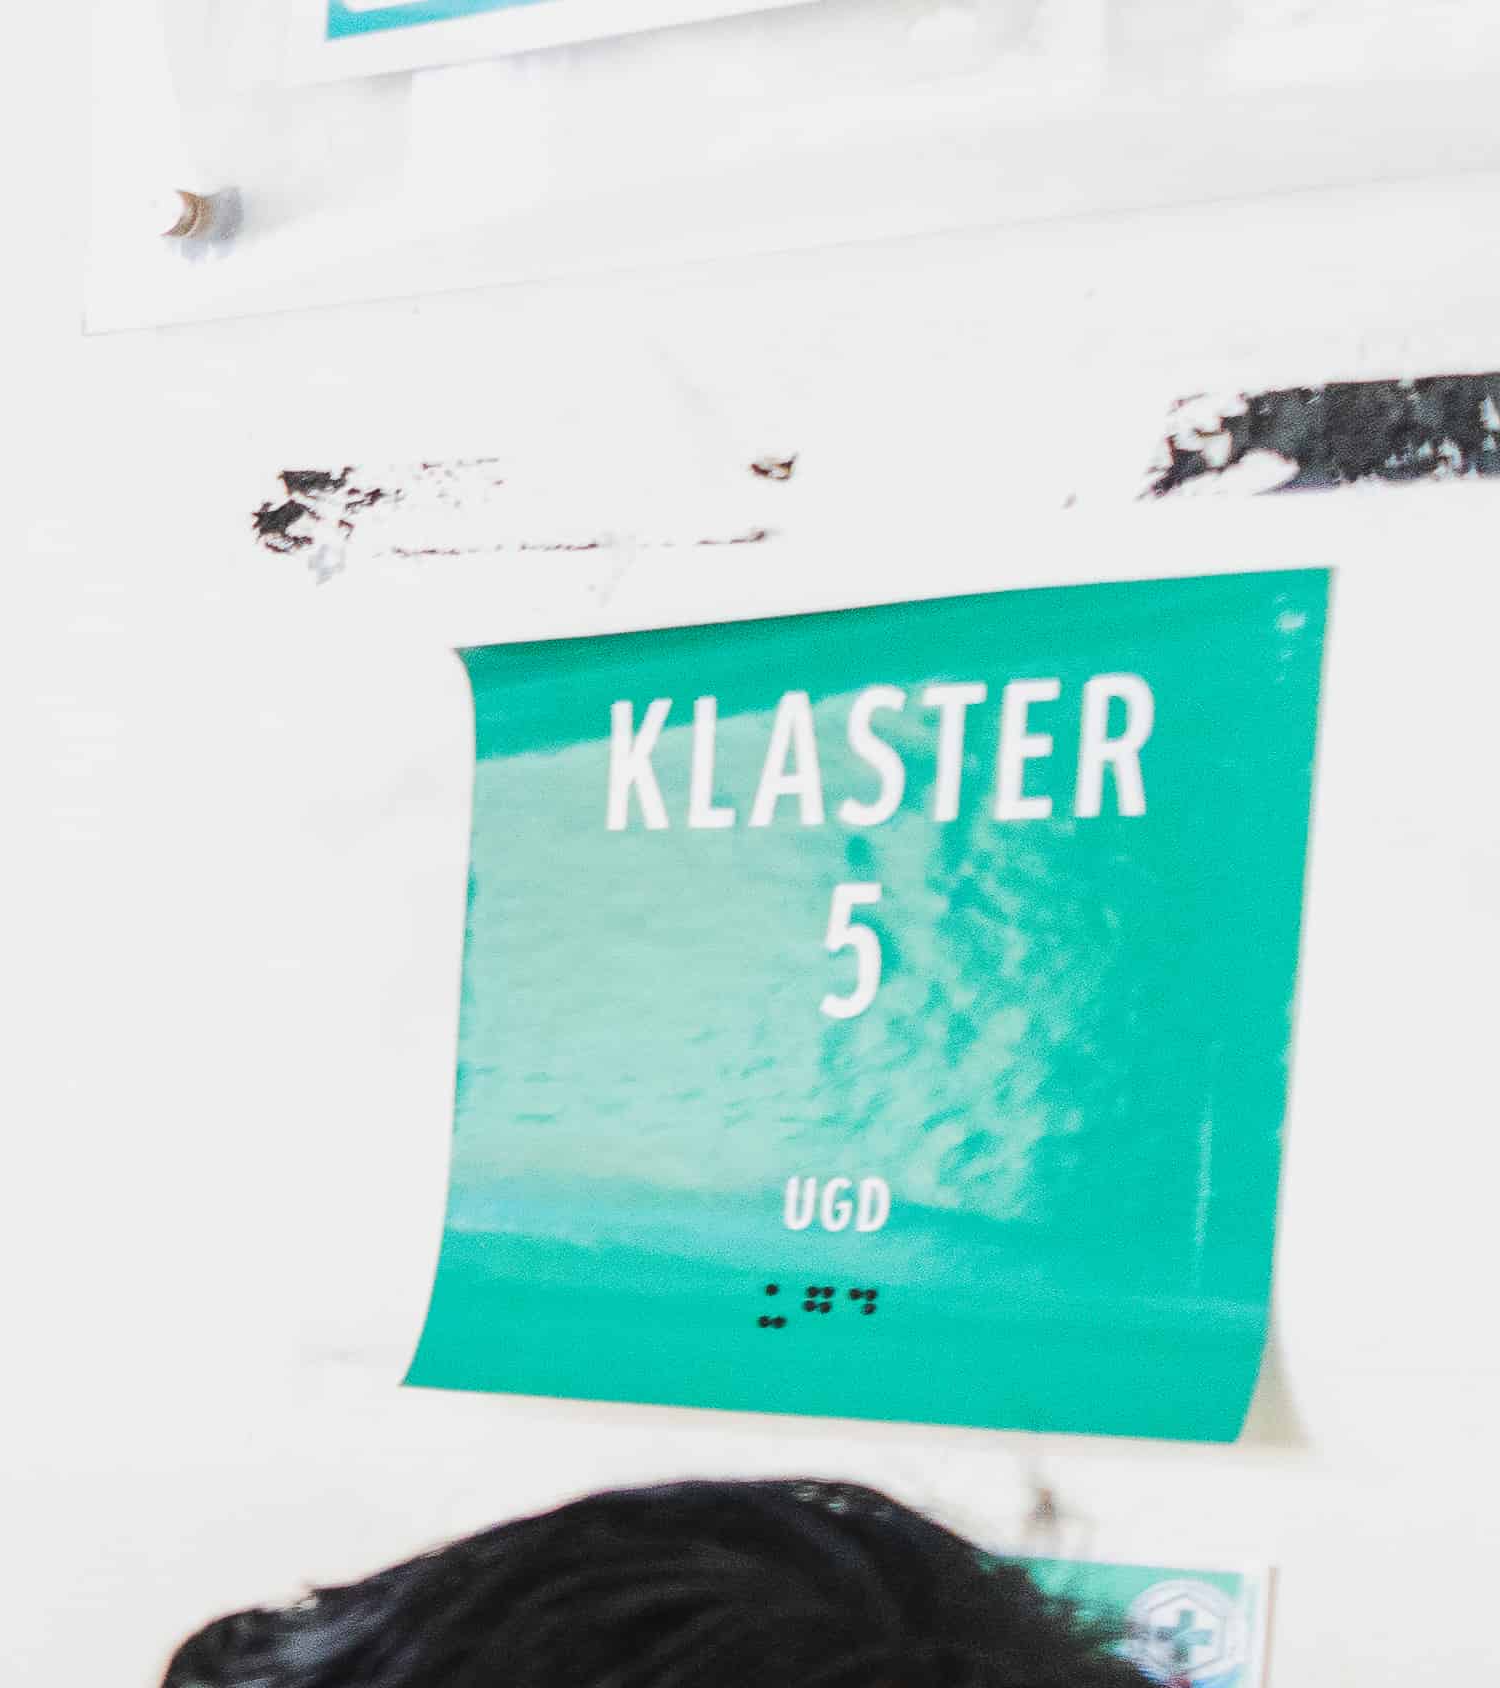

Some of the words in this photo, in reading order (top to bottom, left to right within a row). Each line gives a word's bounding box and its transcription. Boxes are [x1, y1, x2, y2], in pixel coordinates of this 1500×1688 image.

[606, 671, 1157, 832] KLASTER
[818, 880, 884, 1020] 5
[782, 1176, 894, 1233] UGD
